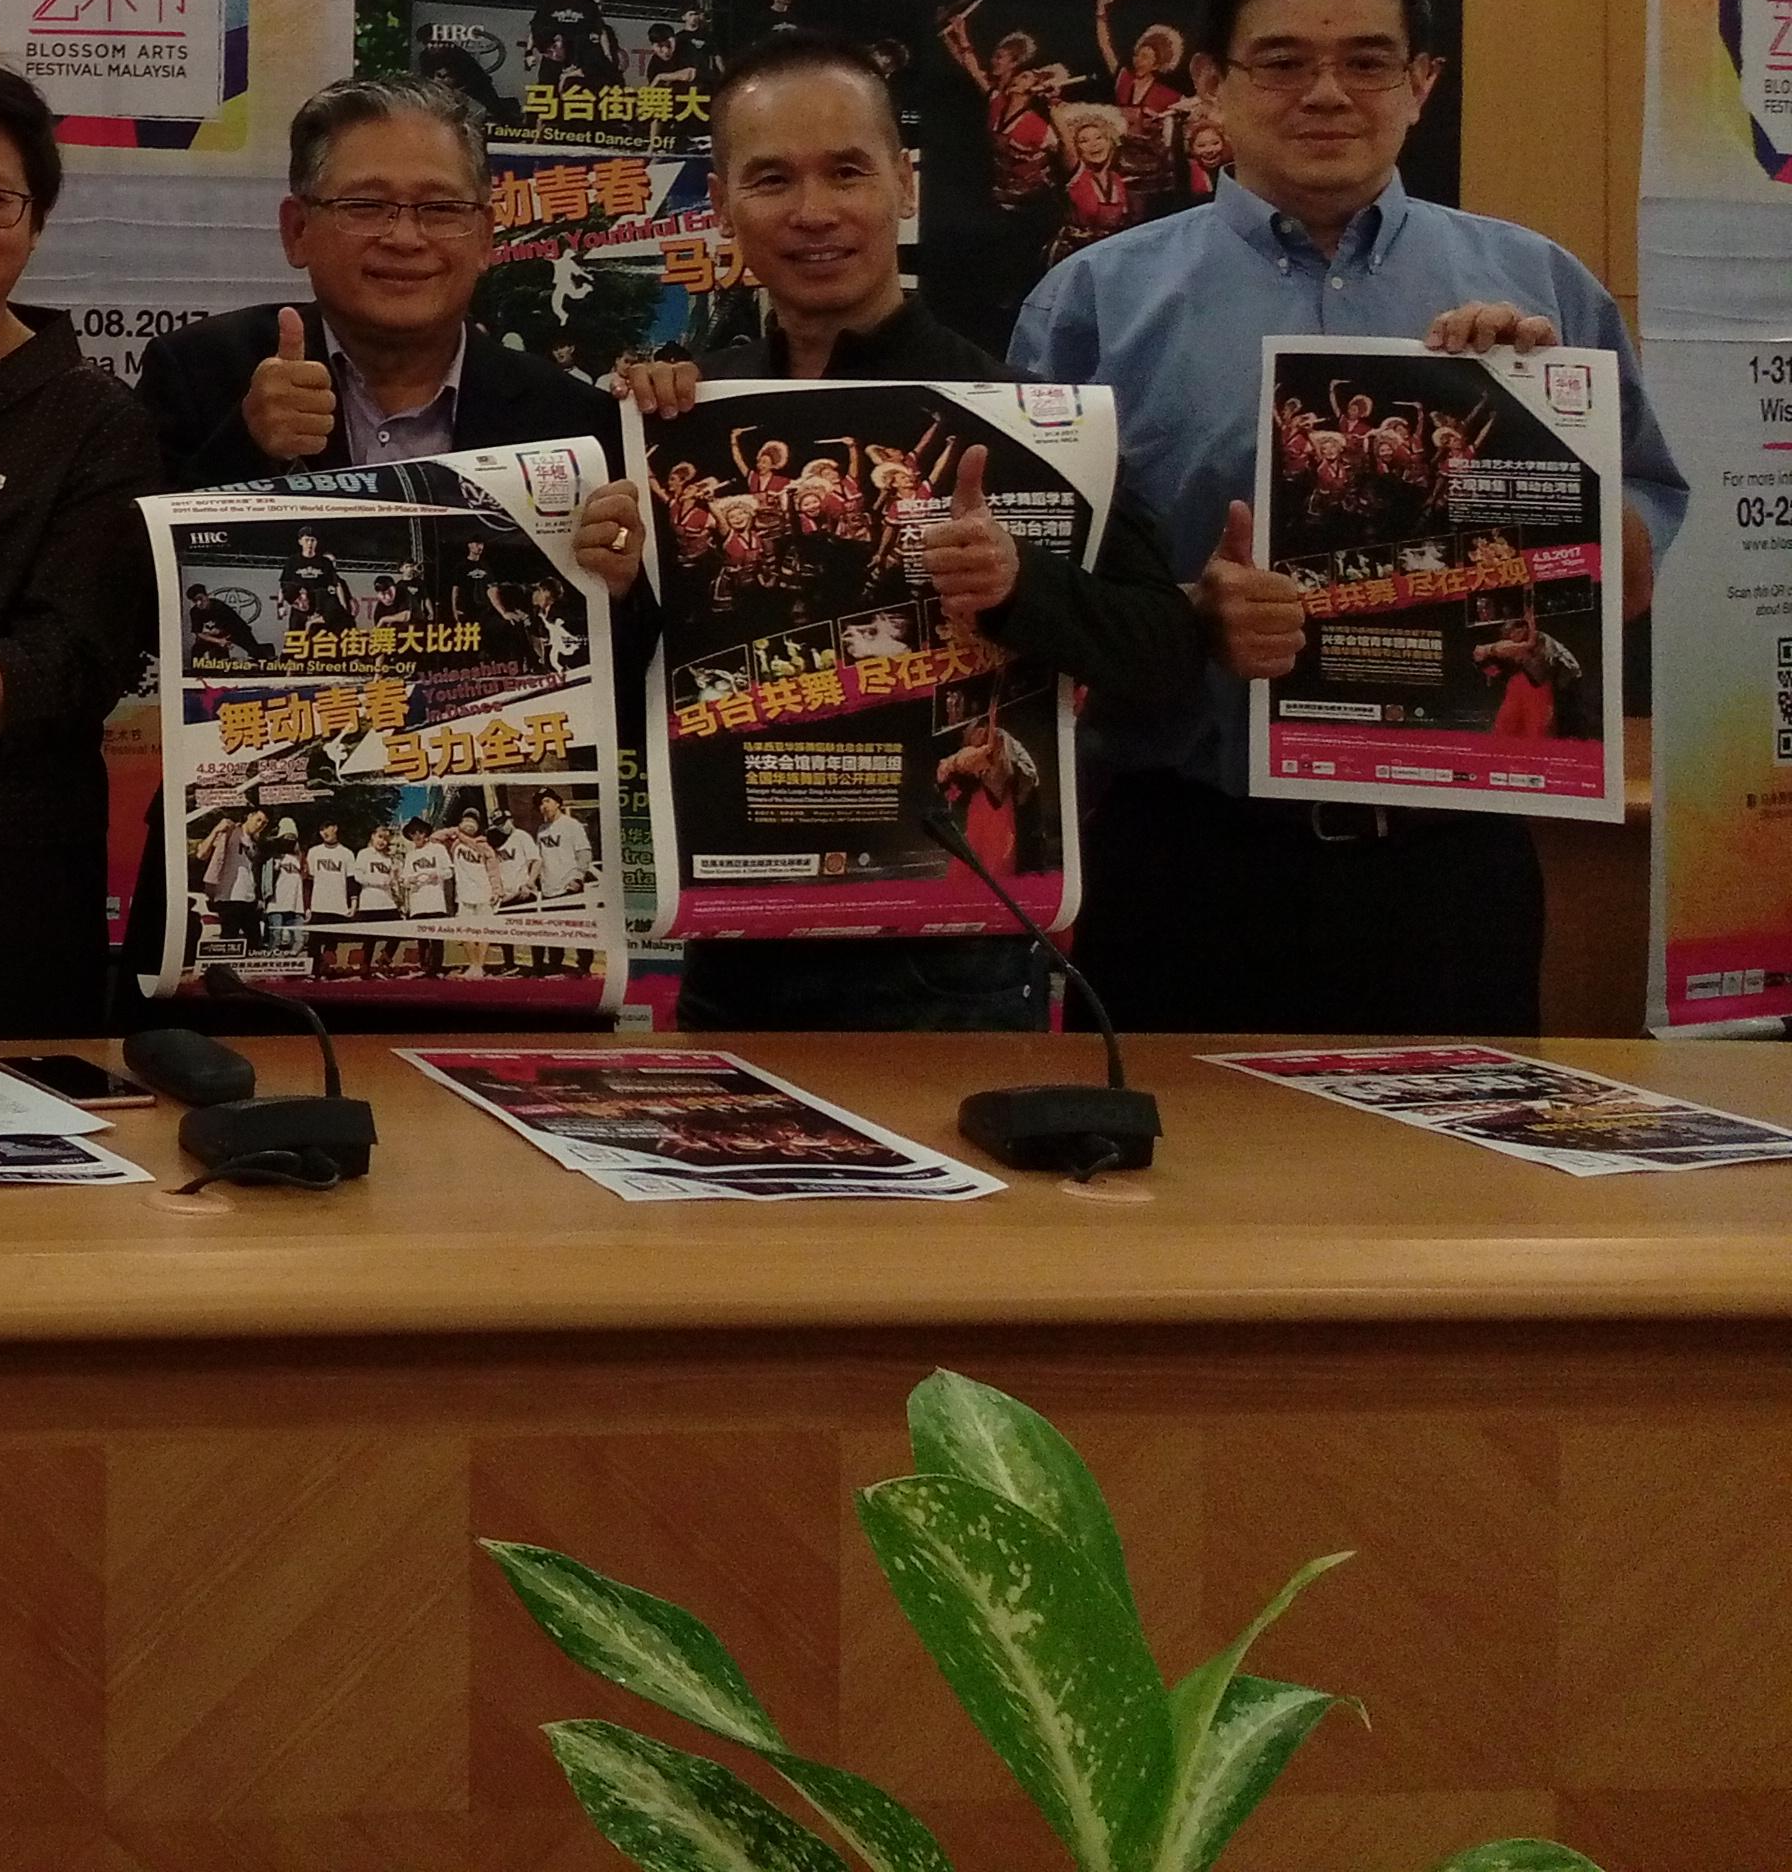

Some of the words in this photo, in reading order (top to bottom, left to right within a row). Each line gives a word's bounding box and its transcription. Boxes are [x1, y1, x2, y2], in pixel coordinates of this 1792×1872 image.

[26, 42, 126, 59] BLOSSOM
[137, 44, 188, 59] ARTS
[26, 62, 102, 77] FESTIVAL
[107, 63, 187, 79] MALAYSIA
[543, 127, 592, 147] Street
[594, 131, 677, 151] Dance-Off
[566, 213, 679, 252] Youthful
[285, 472, 379, 495] BBOY
[190, 531, 229, 546] HRC
[282, 622, 482, 660] 马台街舞大比拼
[306, 661, 347, 675] Street
[674, 669, 846, 738] 马台共舞
[216, 678, 411, 756] 舞动青春
[382, 710, 575, 782] 马力全开
